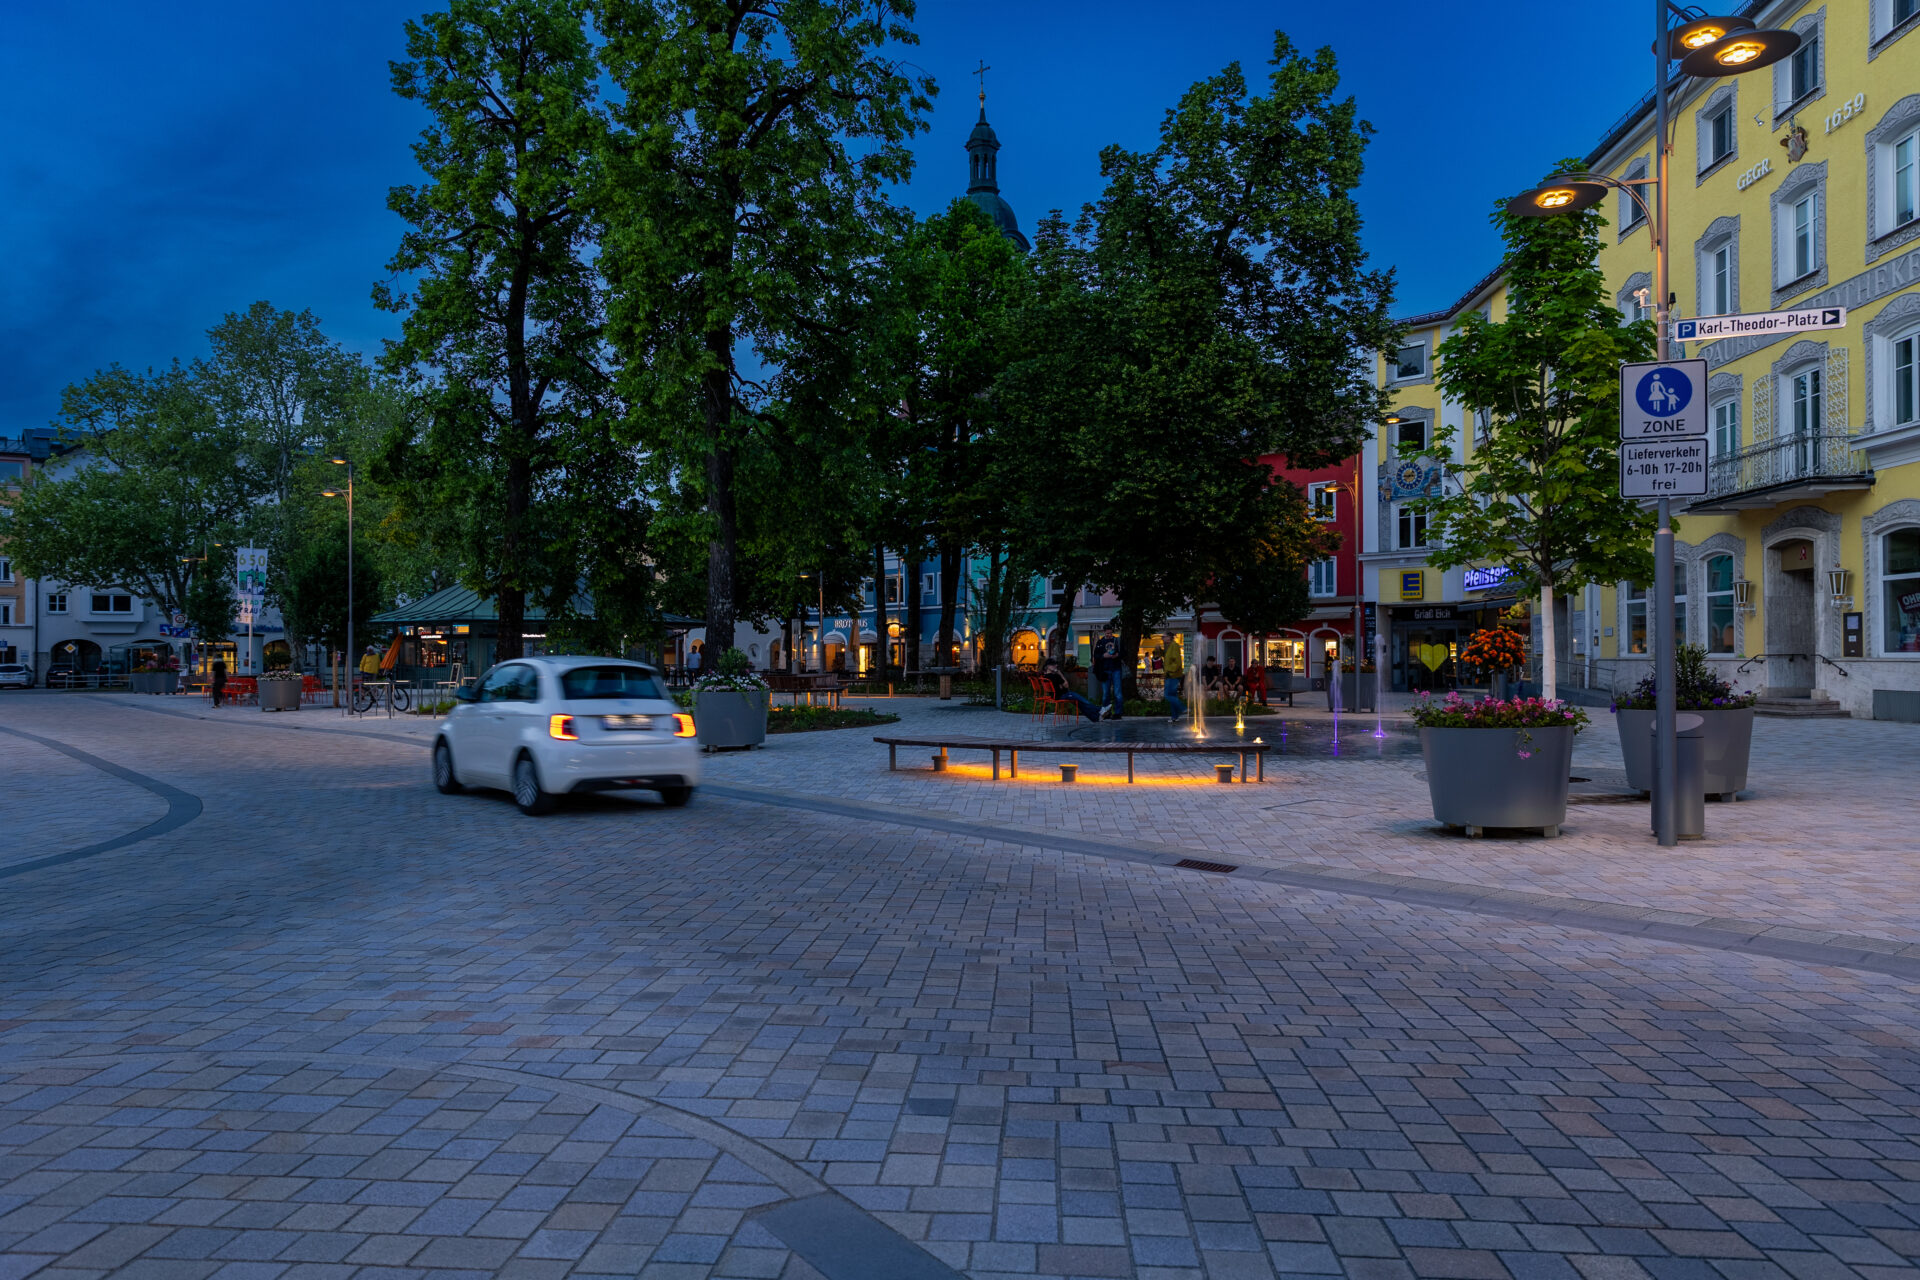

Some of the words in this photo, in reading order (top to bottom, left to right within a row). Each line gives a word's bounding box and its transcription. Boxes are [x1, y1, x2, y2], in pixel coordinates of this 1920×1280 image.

[1824, 92, 1865, 135] 1659
[1736, 158, 1773, 191] GEGR.
[1681, 324, 1692, 336] P
[1699, 313, 1819, 335] Karl-Theodor-Platz
[1643, 419, 1686, 434] ZONE
[1628, 446, 1701, 461] Lieferverkehr
[1652, 479, 1677, 491] frei
